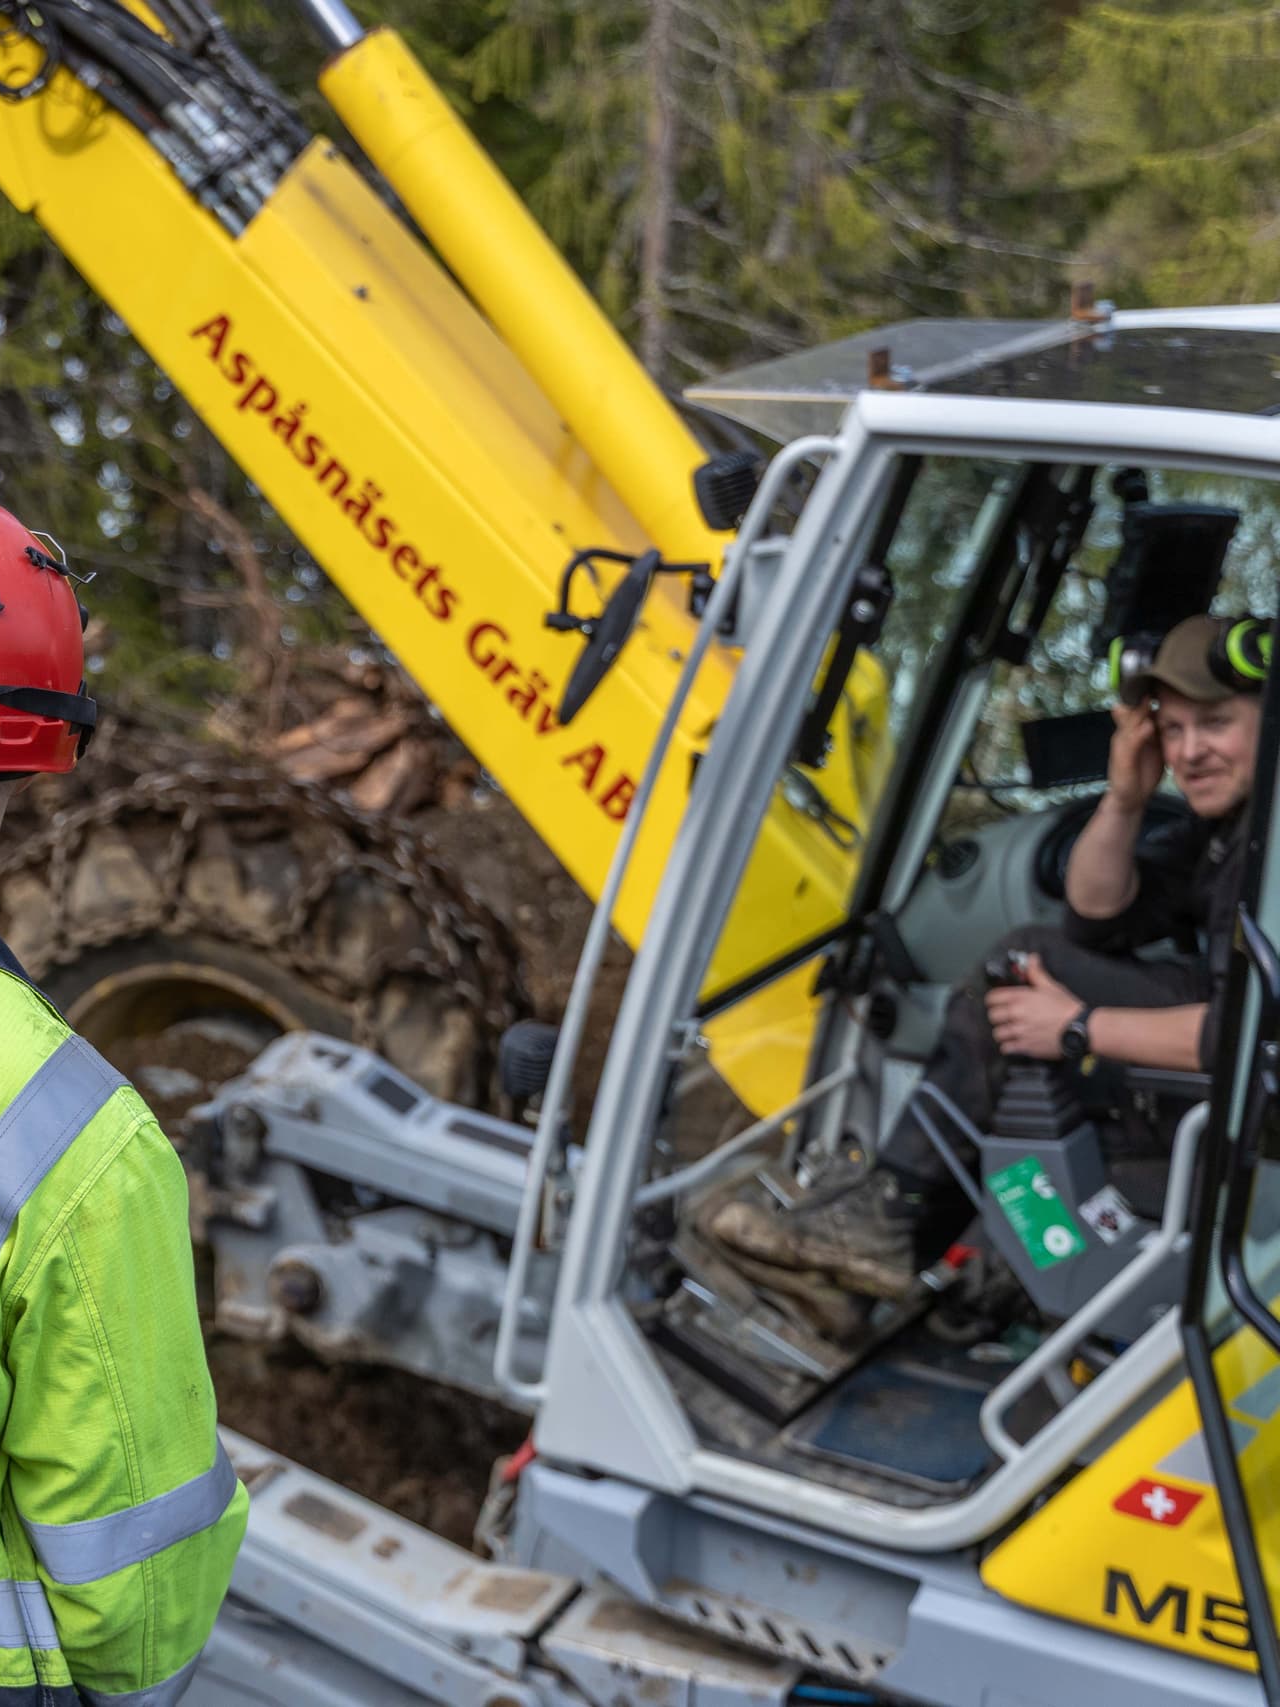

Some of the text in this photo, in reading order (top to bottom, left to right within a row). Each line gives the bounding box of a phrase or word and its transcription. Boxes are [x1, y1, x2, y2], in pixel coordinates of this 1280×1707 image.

[191, 313, 637, 821] Aspåsnäsets Gräv AB
